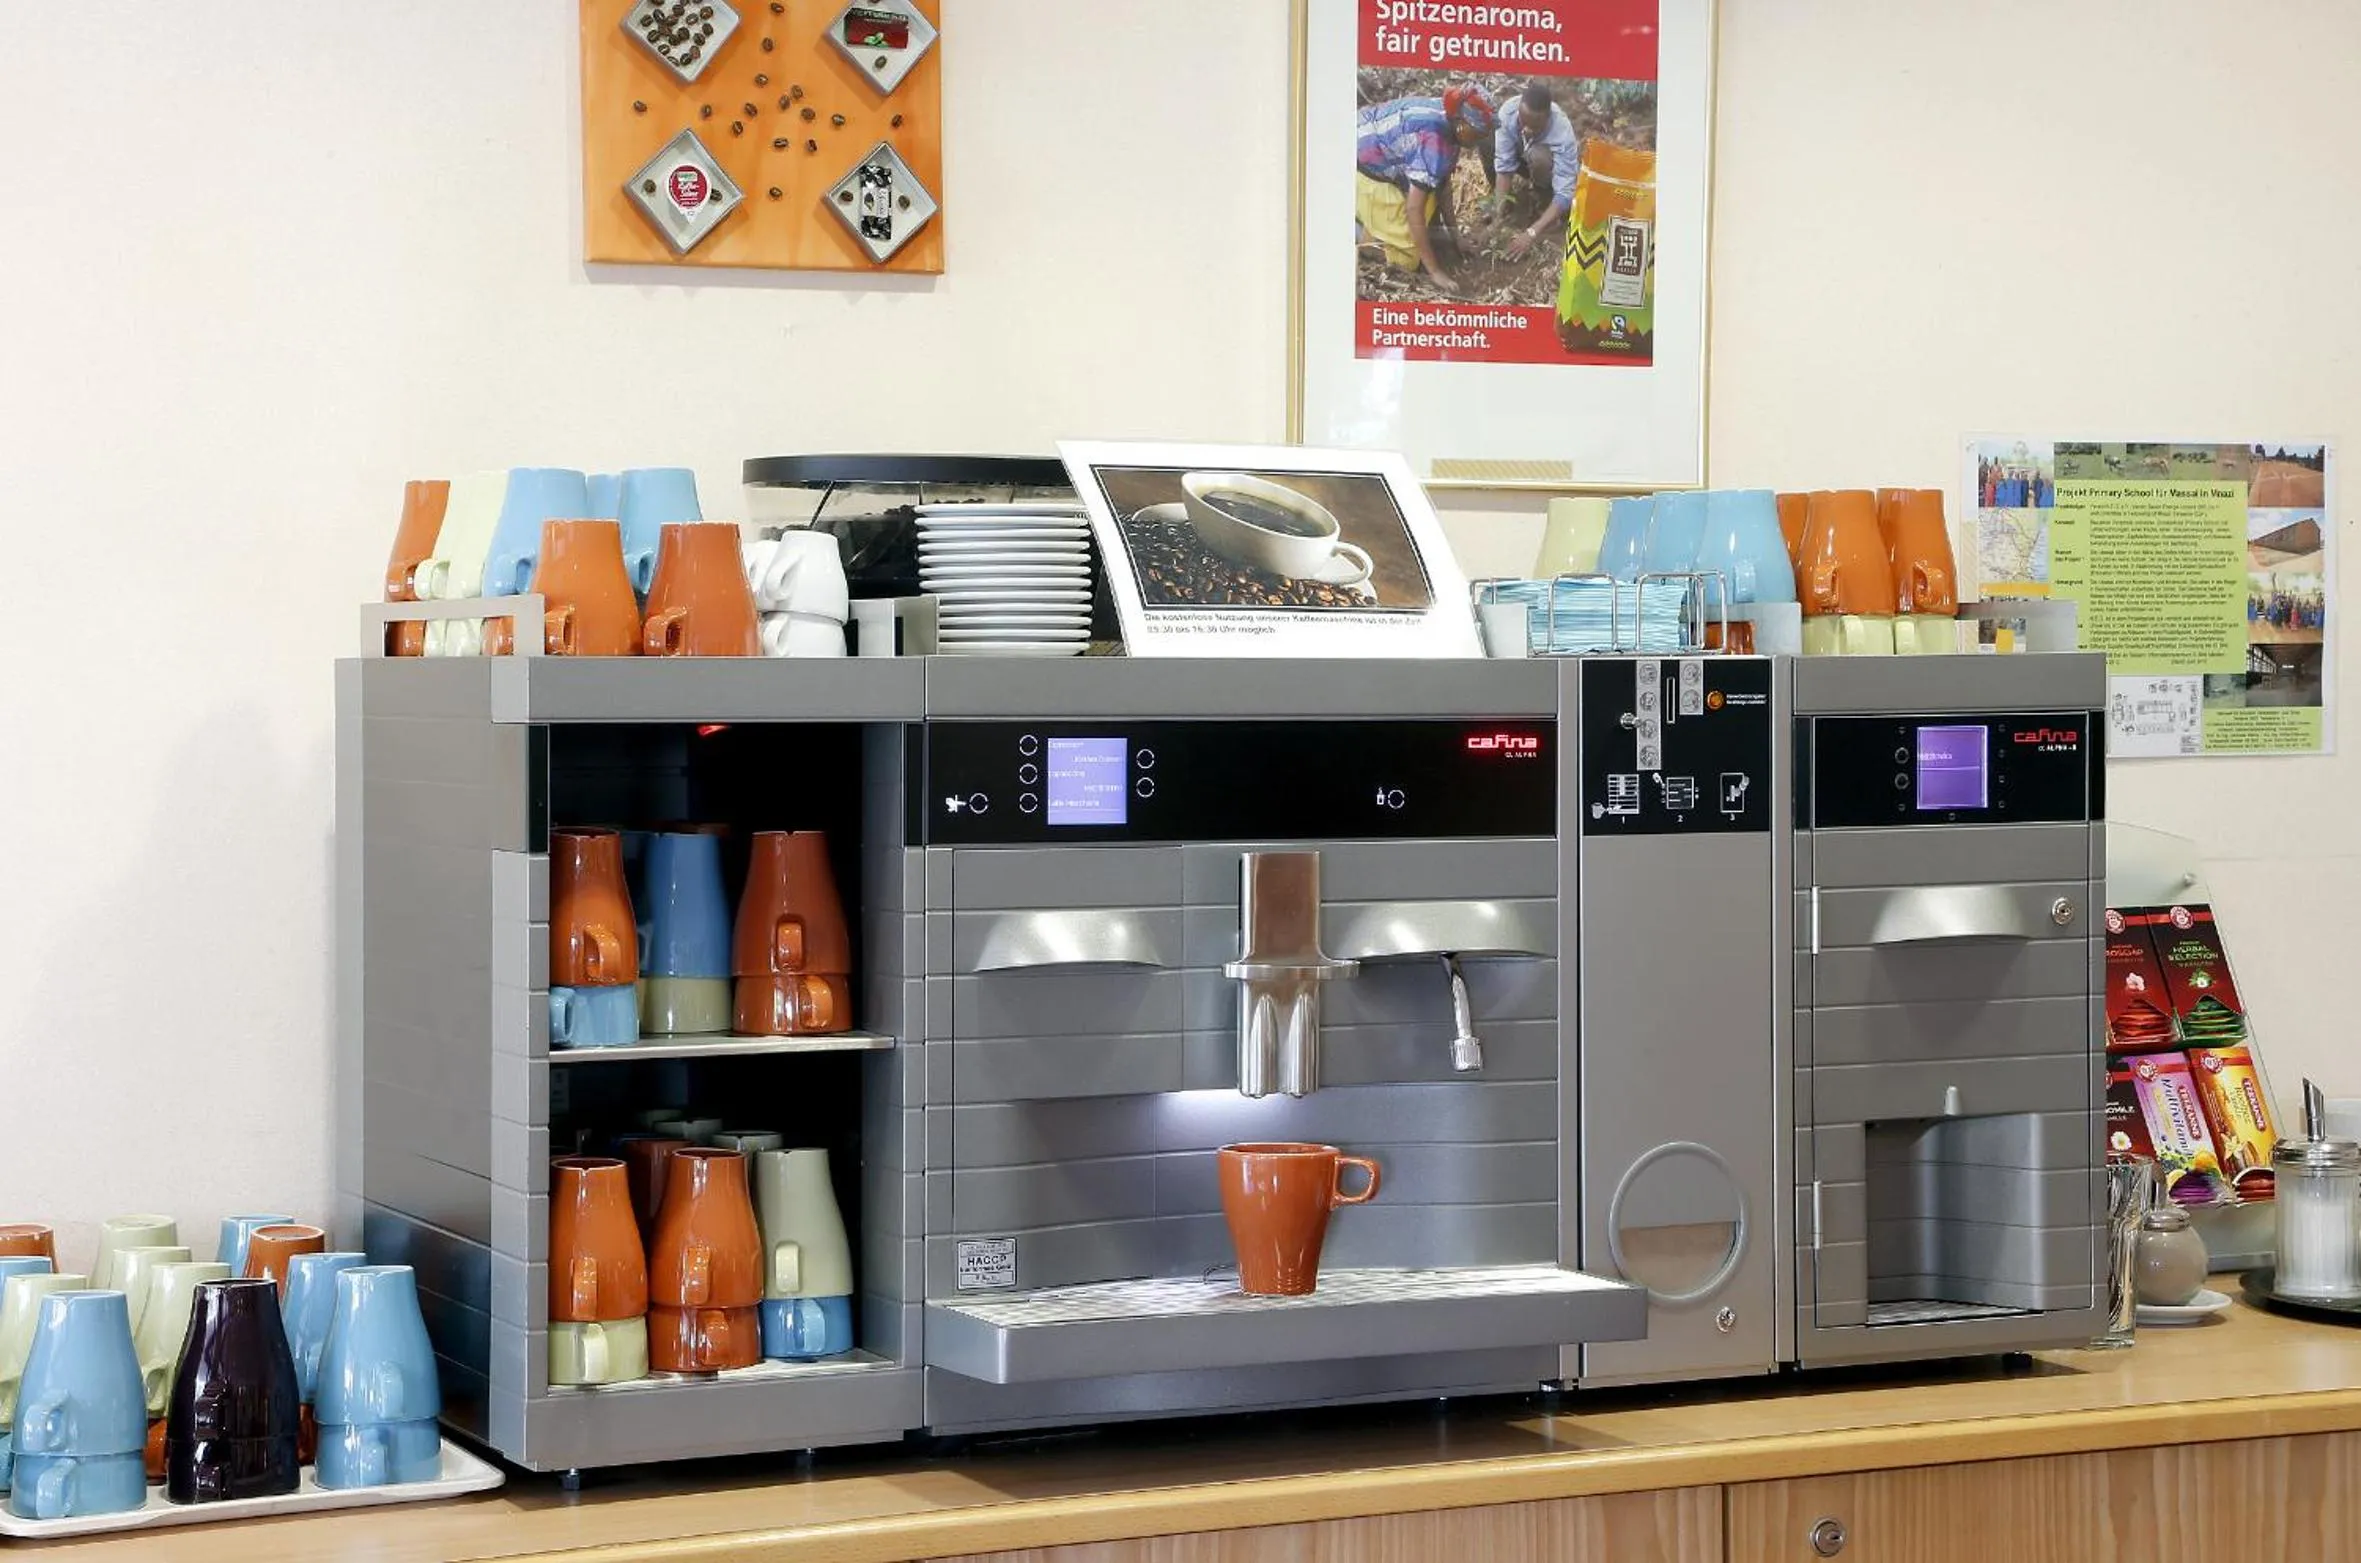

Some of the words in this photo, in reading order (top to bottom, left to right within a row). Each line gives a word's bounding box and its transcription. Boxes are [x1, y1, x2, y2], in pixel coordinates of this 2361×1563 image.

[1376, 0, 1562, 33] Spitzenaroma,
[1376, 26, 1420, 54] fair
[1429, 33, 1571, 62] getrunken.
[1373, 308, 1409, 325] Eine
[1414, 308, 1528, 329] bekömmliche
[1373, 329, 1491, 349] Partnerschaft.
[1468, 735, 1537, 748] cafina
[2014, 728, 2077, 742] cafina
